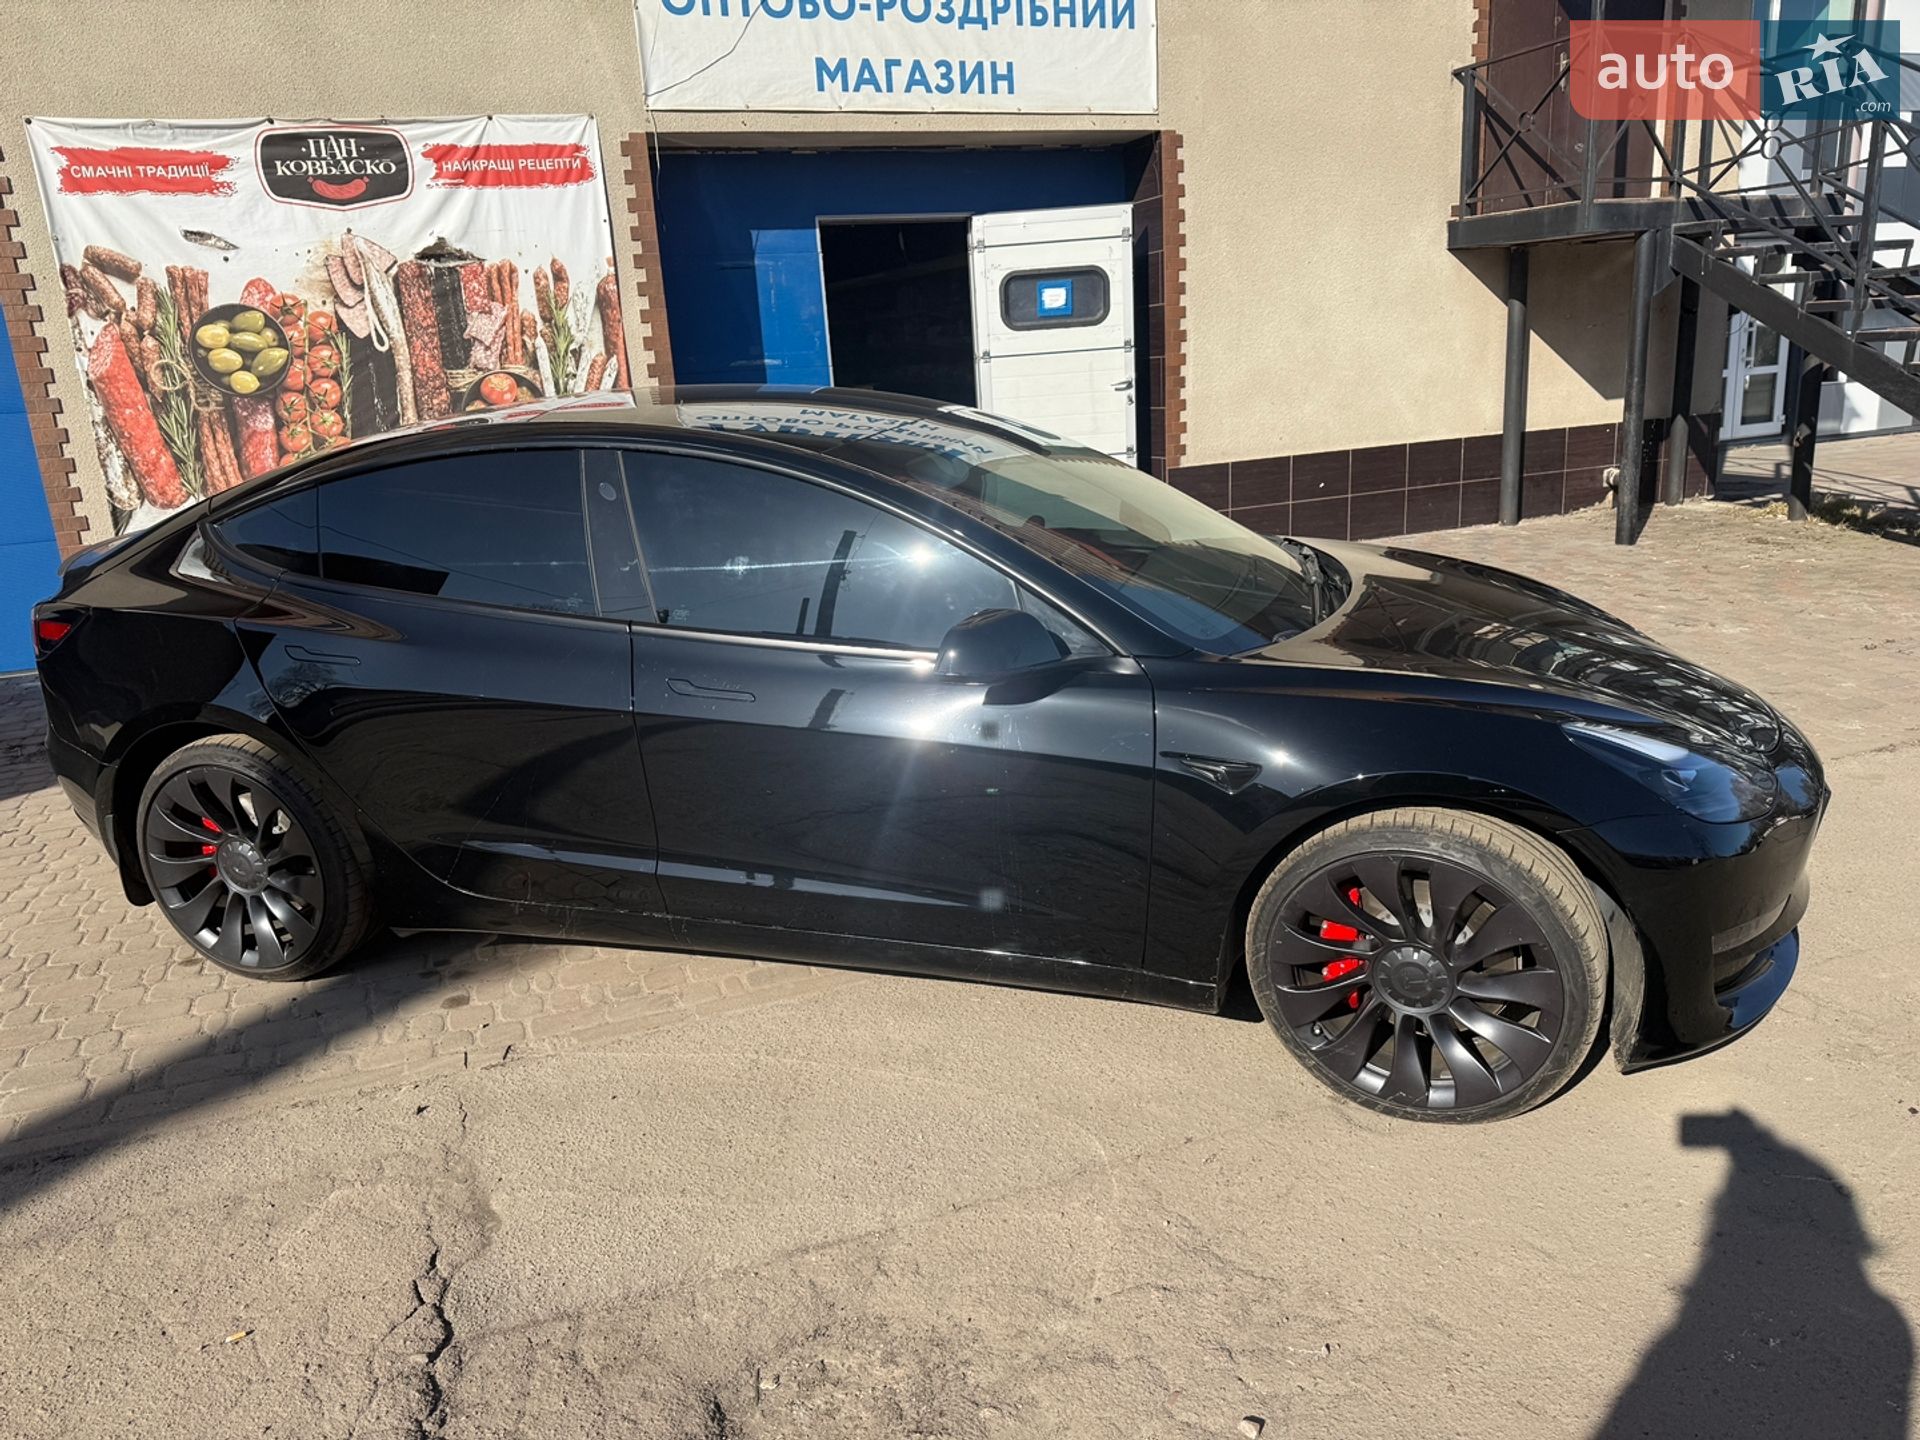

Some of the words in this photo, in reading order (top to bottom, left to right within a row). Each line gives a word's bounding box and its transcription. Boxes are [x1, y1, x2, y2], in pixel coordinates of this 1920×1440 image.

[815, 57, 1015, 94] МАГАЗИН
[307, 135, 358, 160] ПАН
[70, 165, 132, 179] СМАЧНІ
[136, 163, 210, 180] ТРАДИЦІЇ
[274, 159, 397, 176] КОВБАСКО
[442, 157, 515, 173] НАЙКРАЩІ
[518, 157, 582, 172] РЕЦЕПТИ
